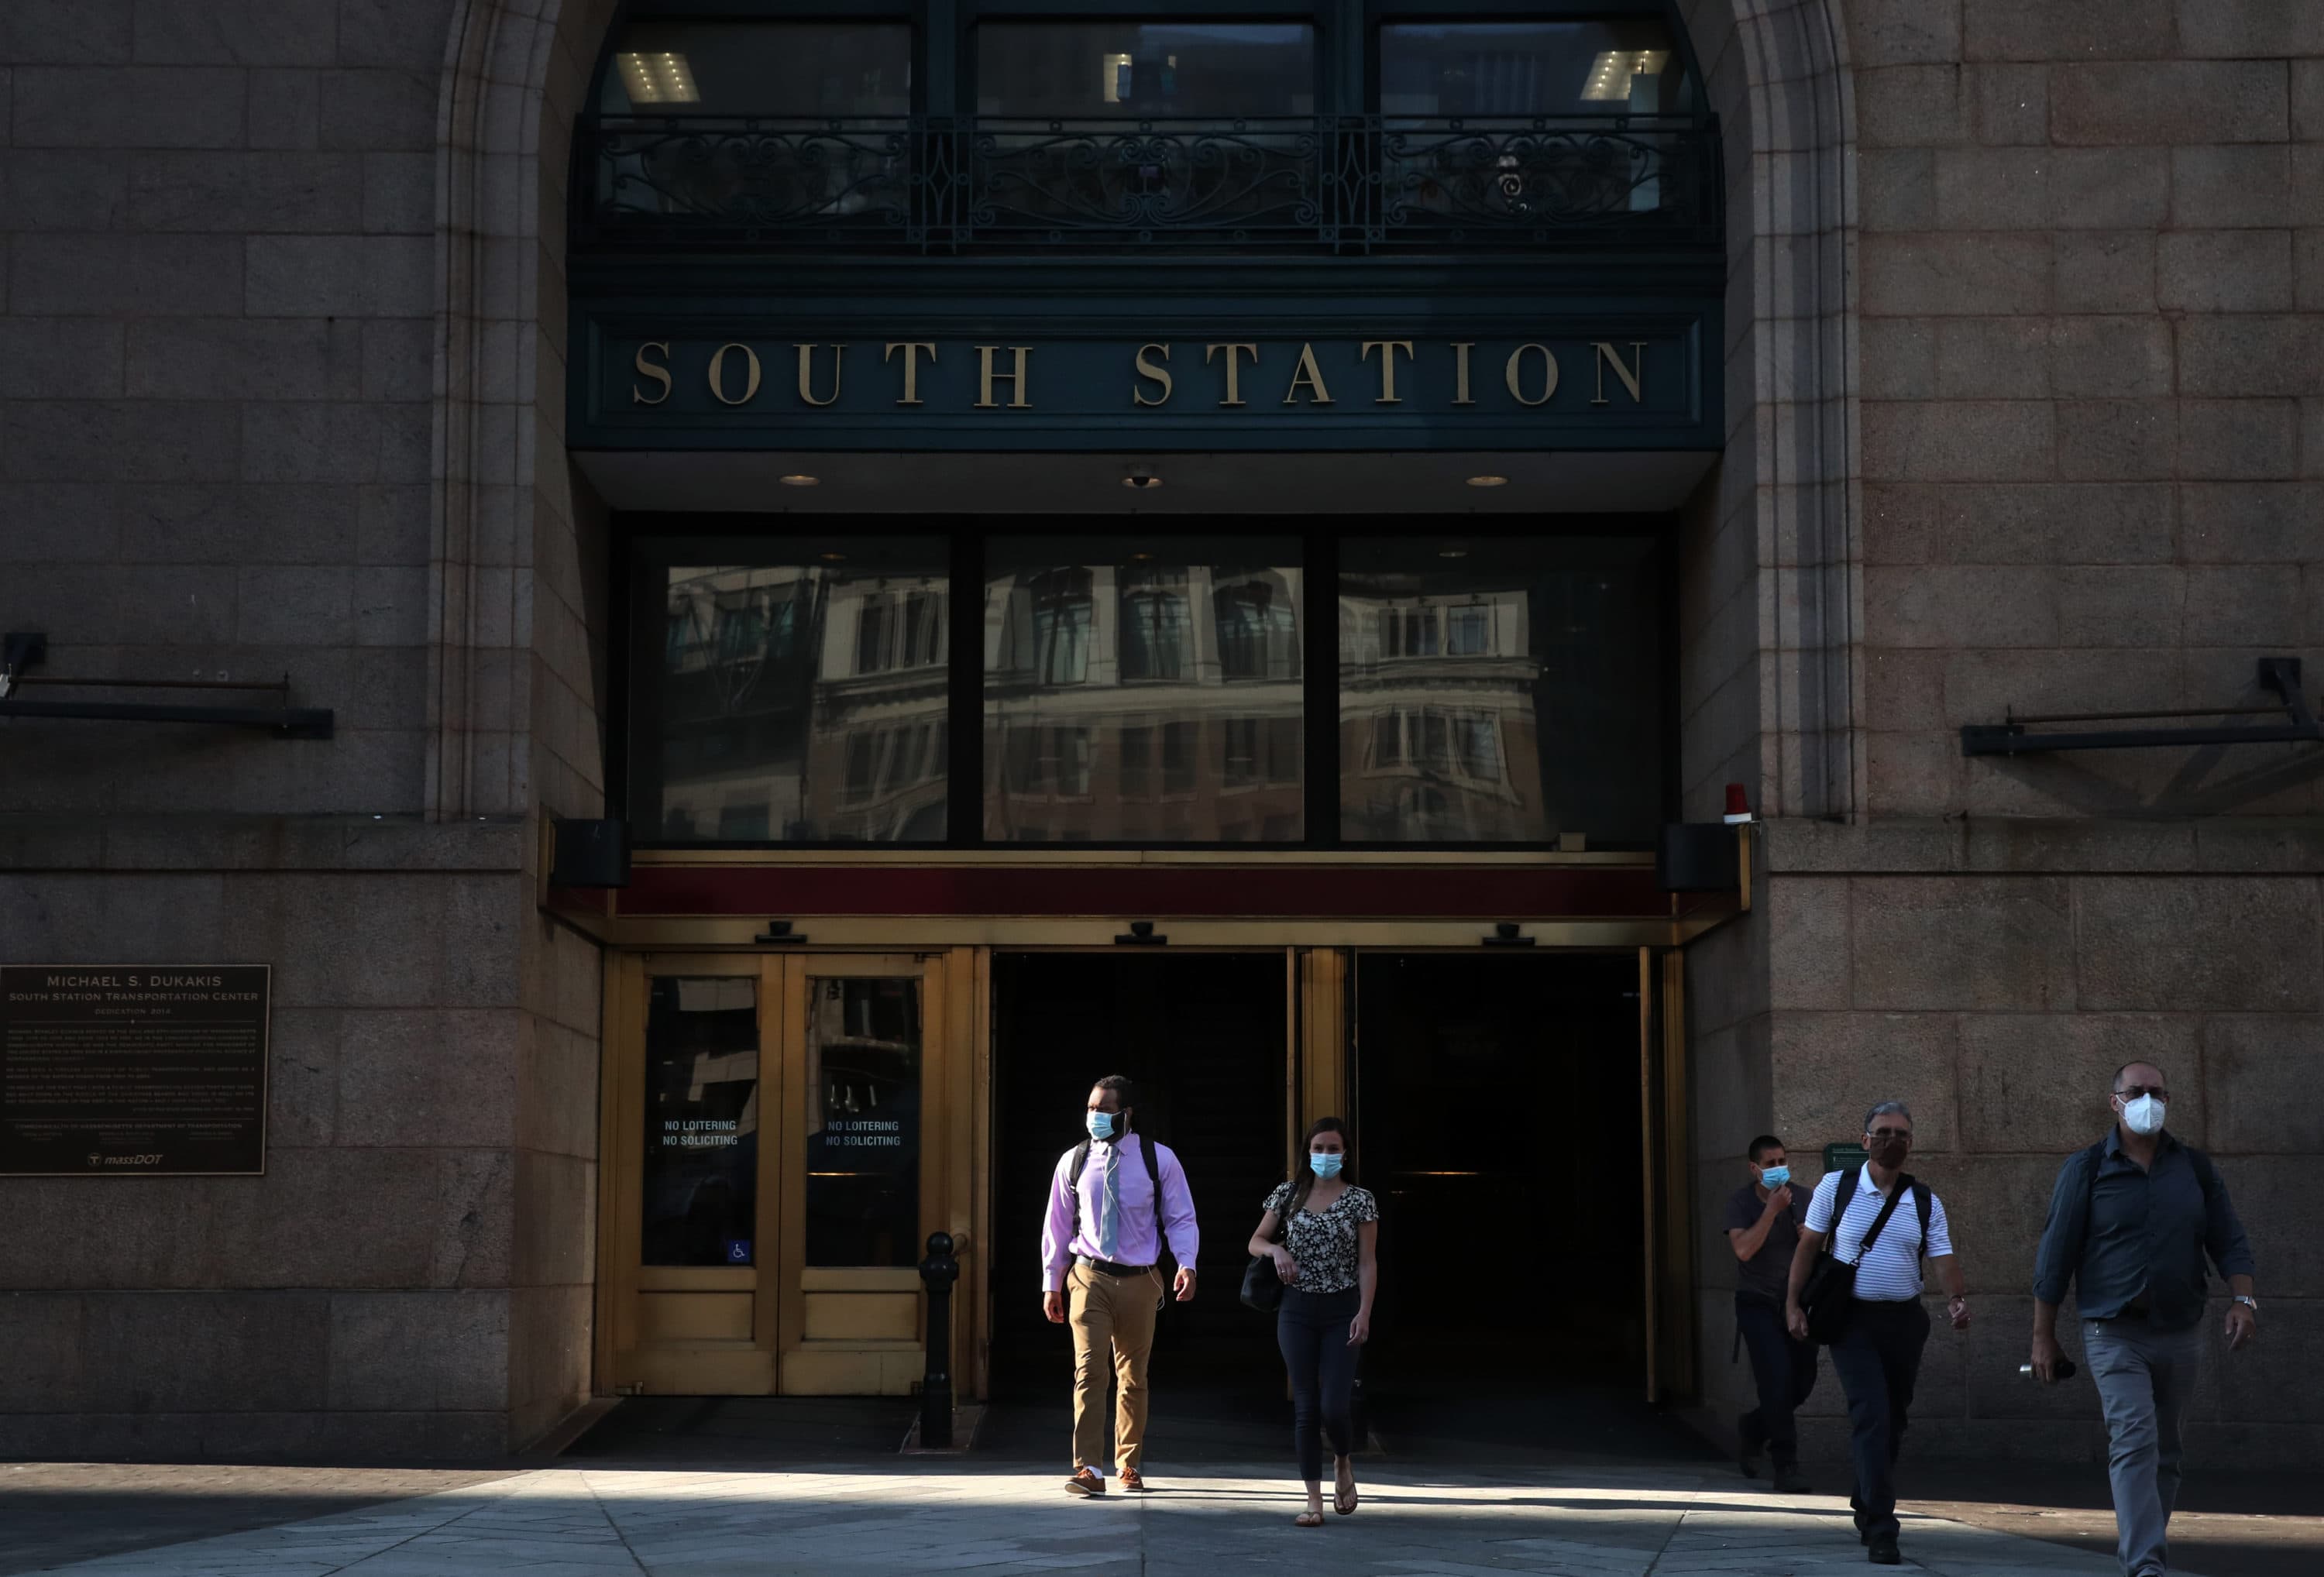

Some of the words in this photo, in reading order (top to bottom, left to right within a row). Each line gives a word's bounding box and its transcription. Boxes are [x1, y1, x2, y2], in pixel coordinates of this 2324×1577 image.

[632, 341, 1033, 407] SOUTH
[1134, 340, 1648, 407] STATION
[47, 975, 121, 987] MICHAEL
[128, 975, 142, 987] S.
[150, 975, 222, 987] DUKAKIS
[9, 992, 48, 1002] SOUTH
[53, 992, 101, 1002] STATION
[105, 992, 208, 1002] TRANSPORTATION
[213, 992, 259, 1002] CENTER
[665, 1120, 679, 1130] NO
[682, 1120, 737, 1130] LOITERING
[827, 1121, 843, 1131] NO
[845, 1121, 899, 1131] LOITERING
[662, 1135, 678, 1146] NO
[680, 1135, 738, 1146] SOLICITING
[826, 1136, 841, 1146] NO
[843, 1136, 901, 1146] SOLICITING
[104, 1154, 163, 1165] massDOT
